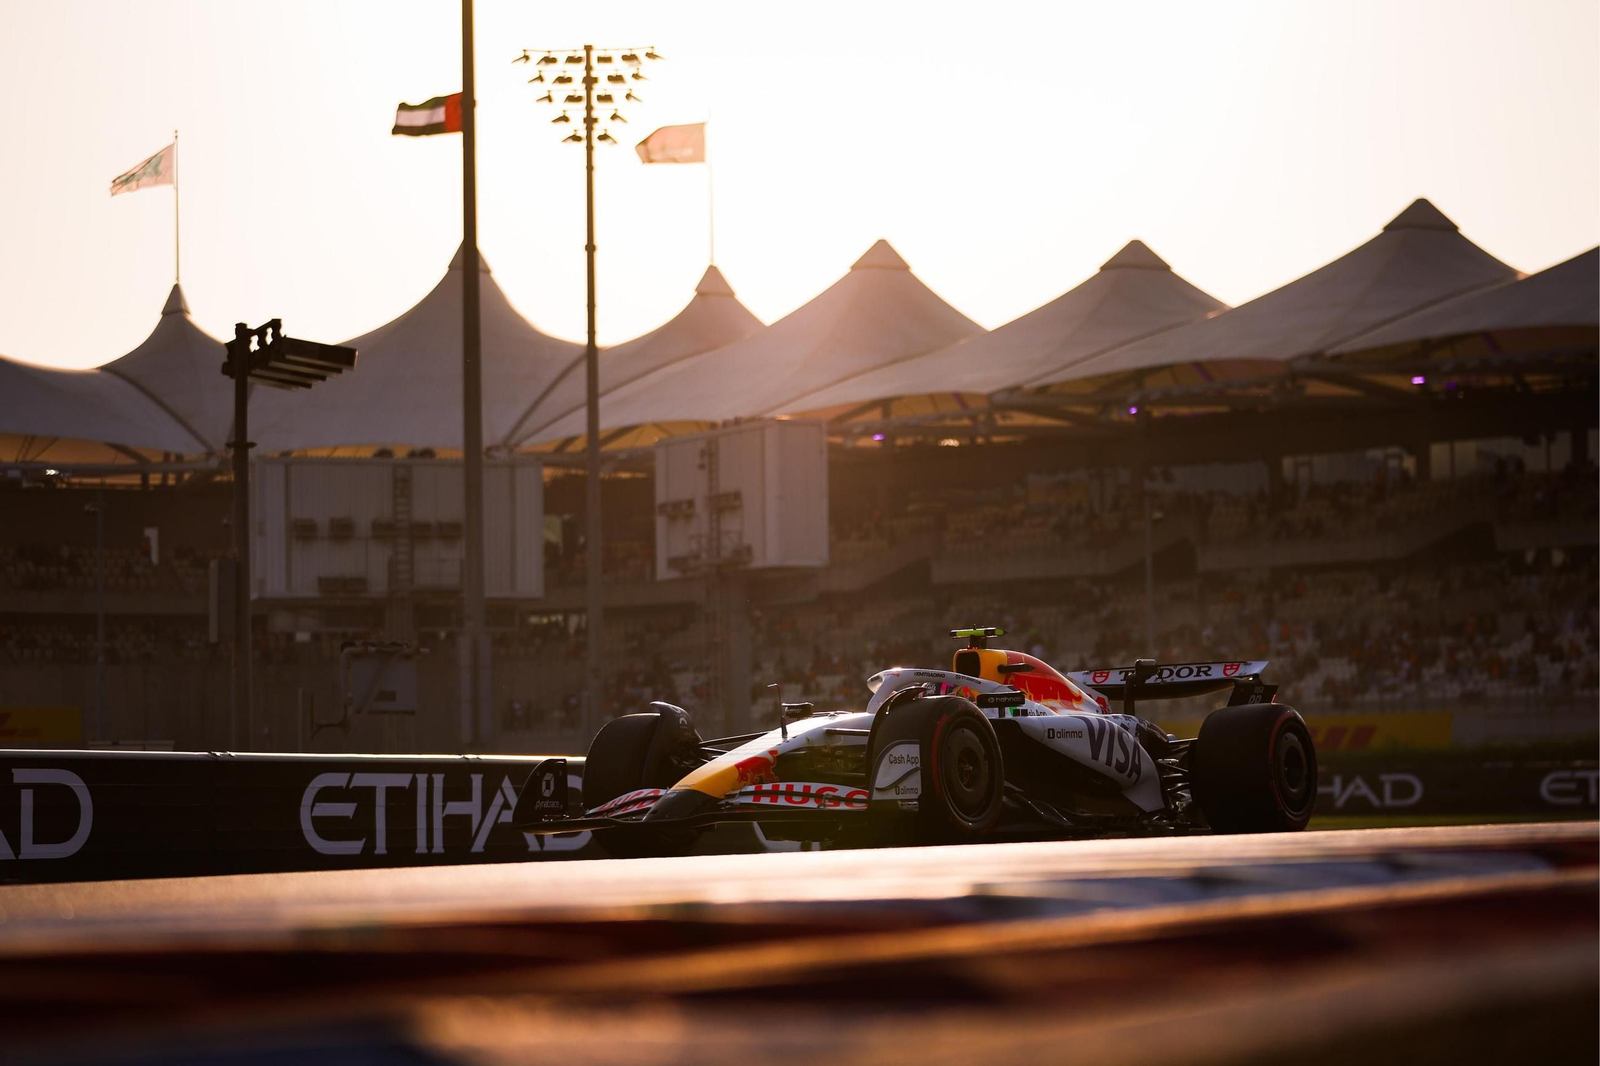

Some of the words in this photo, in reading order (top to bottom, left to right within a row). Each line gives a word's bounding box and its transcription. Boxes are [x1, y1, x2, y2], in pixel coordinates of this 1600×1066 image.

[1118, 665, 1212, 682] TDOR
[1056, 728, 1083, 739] alinma
[1070, 716, 1142, 786] VISA
[888, 753, 905, 765] Cash
[905, 753, 919, 767] App
[534, 799, 560, 811] dynatrace
[753, 784, 869, 809] HUGO
[0, 767, 94, 861] D
